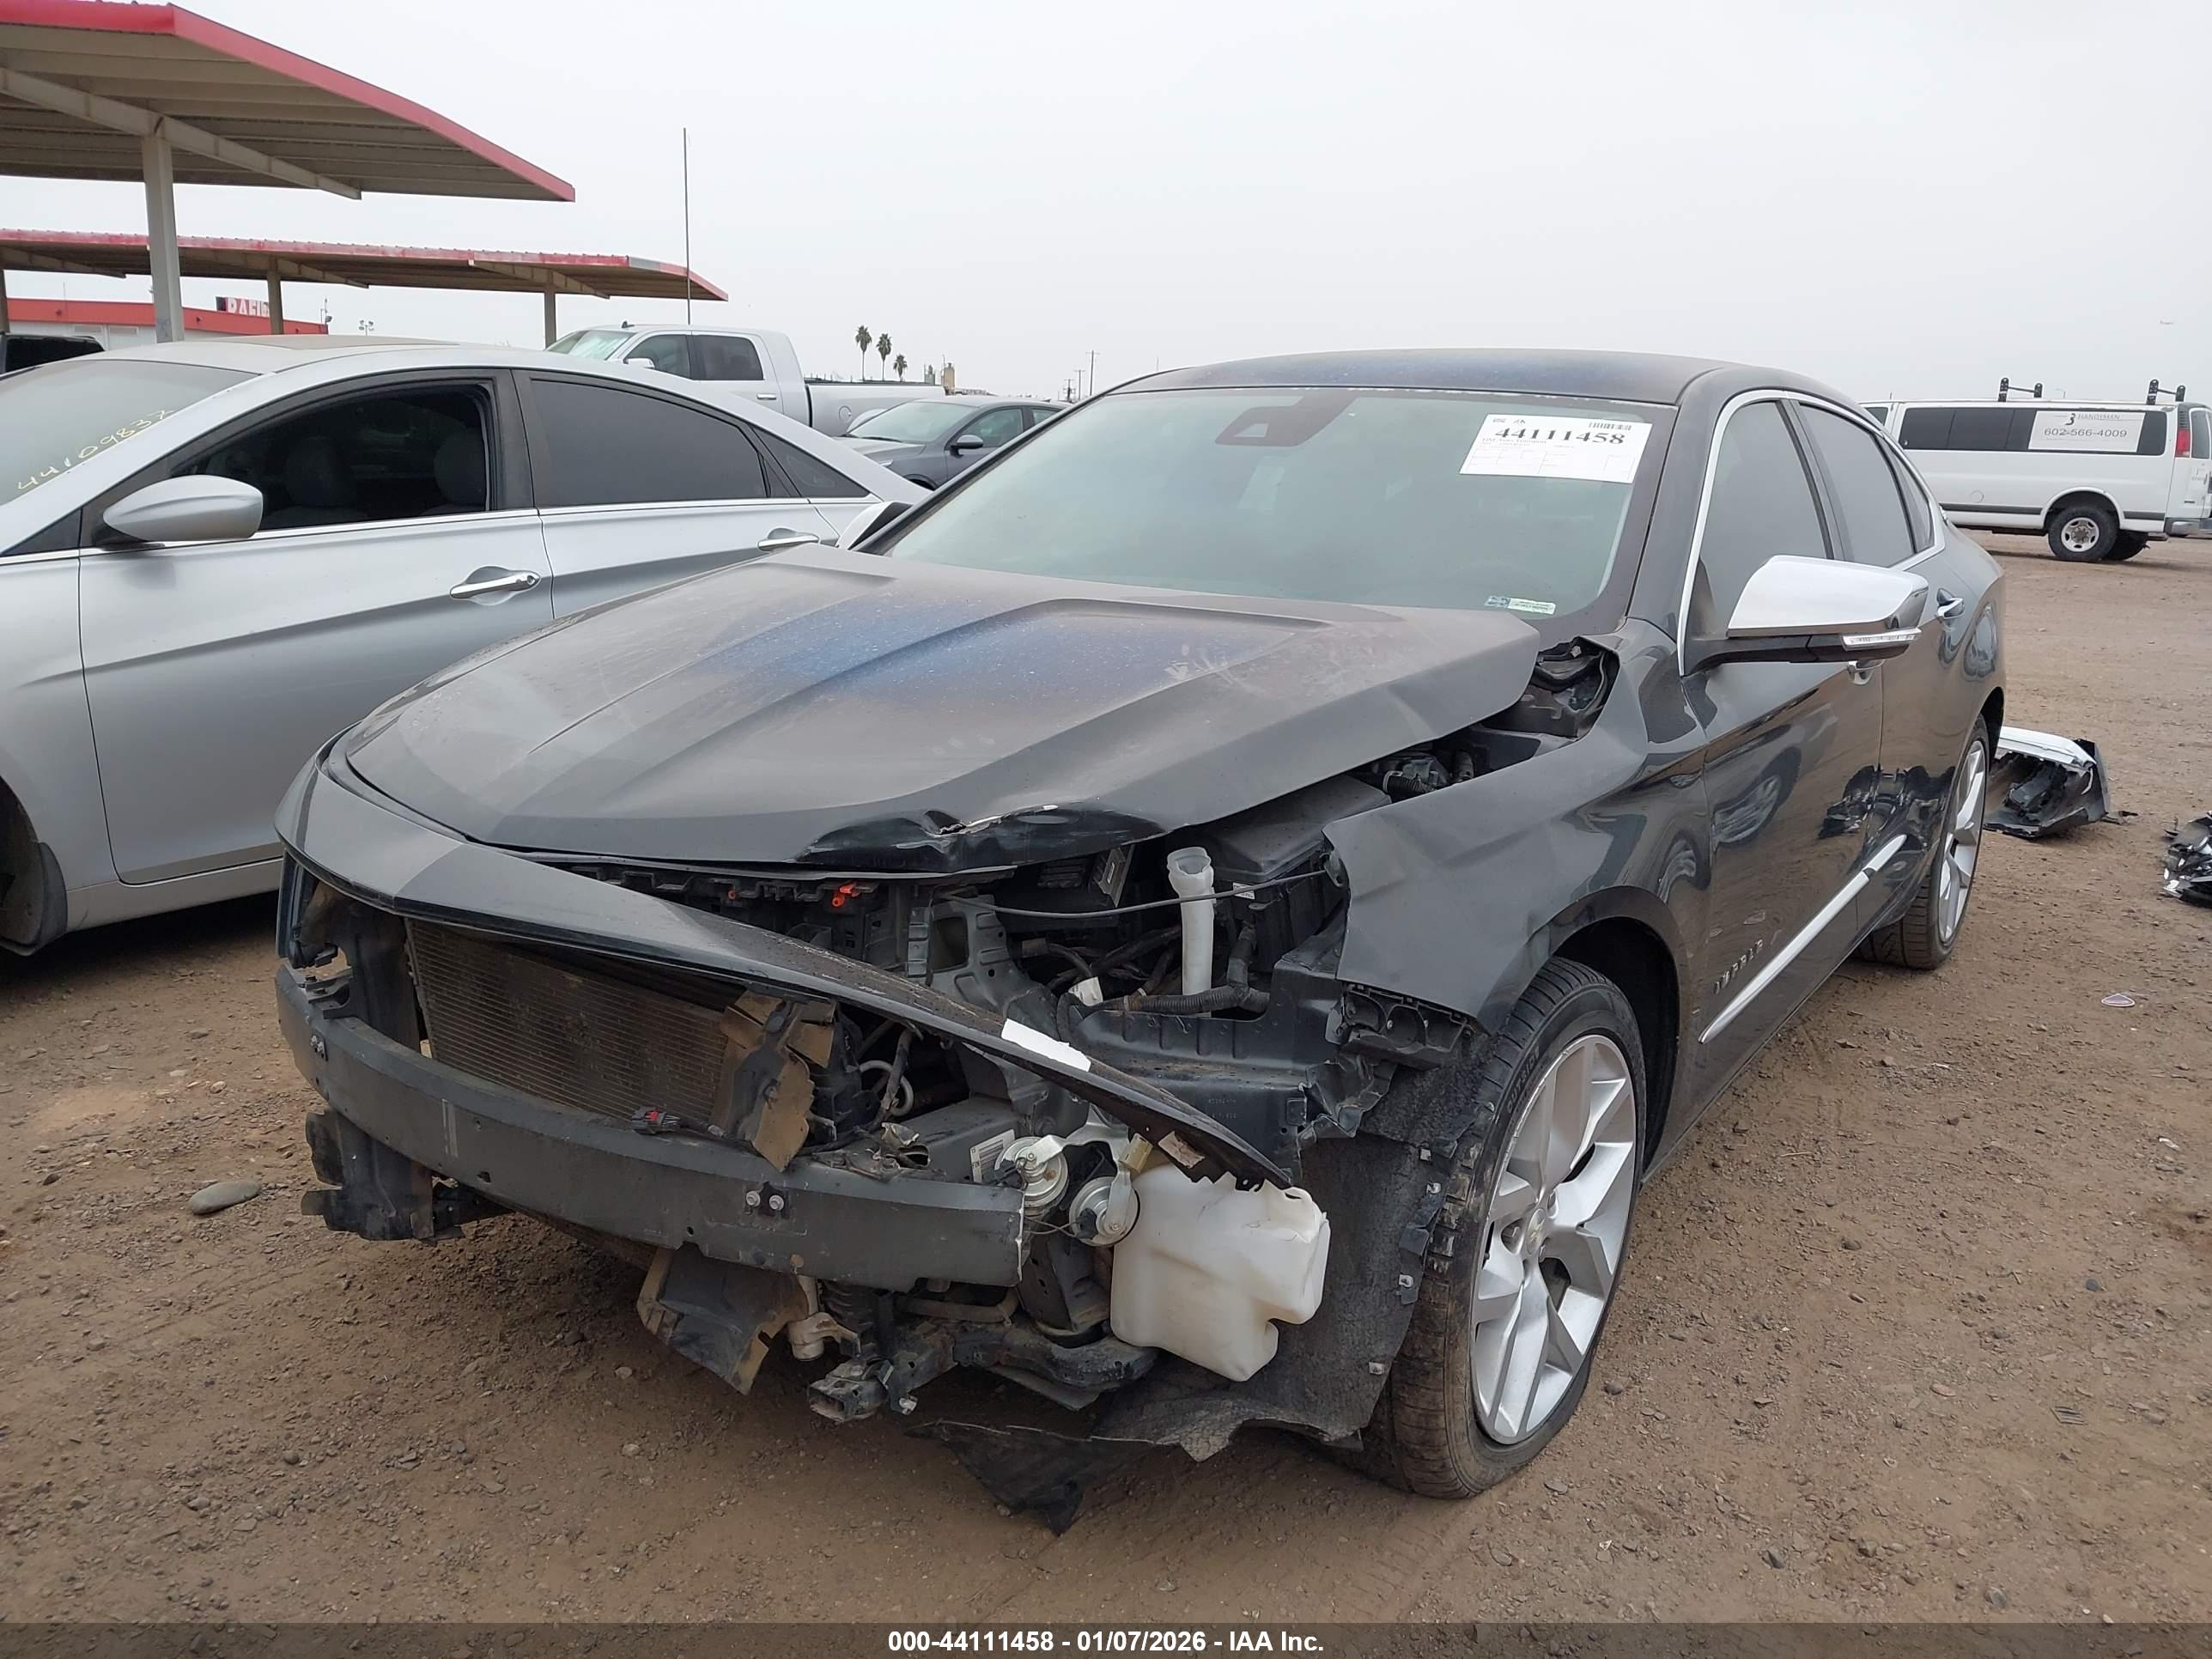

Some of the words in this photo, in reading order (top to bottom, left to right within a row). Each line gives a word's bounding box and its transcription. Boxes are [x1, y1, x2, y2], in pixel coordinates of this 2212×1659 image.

[1494, 428, 1626, 445] 44111458
[2044, 428, 2128, 439] 602-566-4009
[17, 410, 174, 489] 44109837
